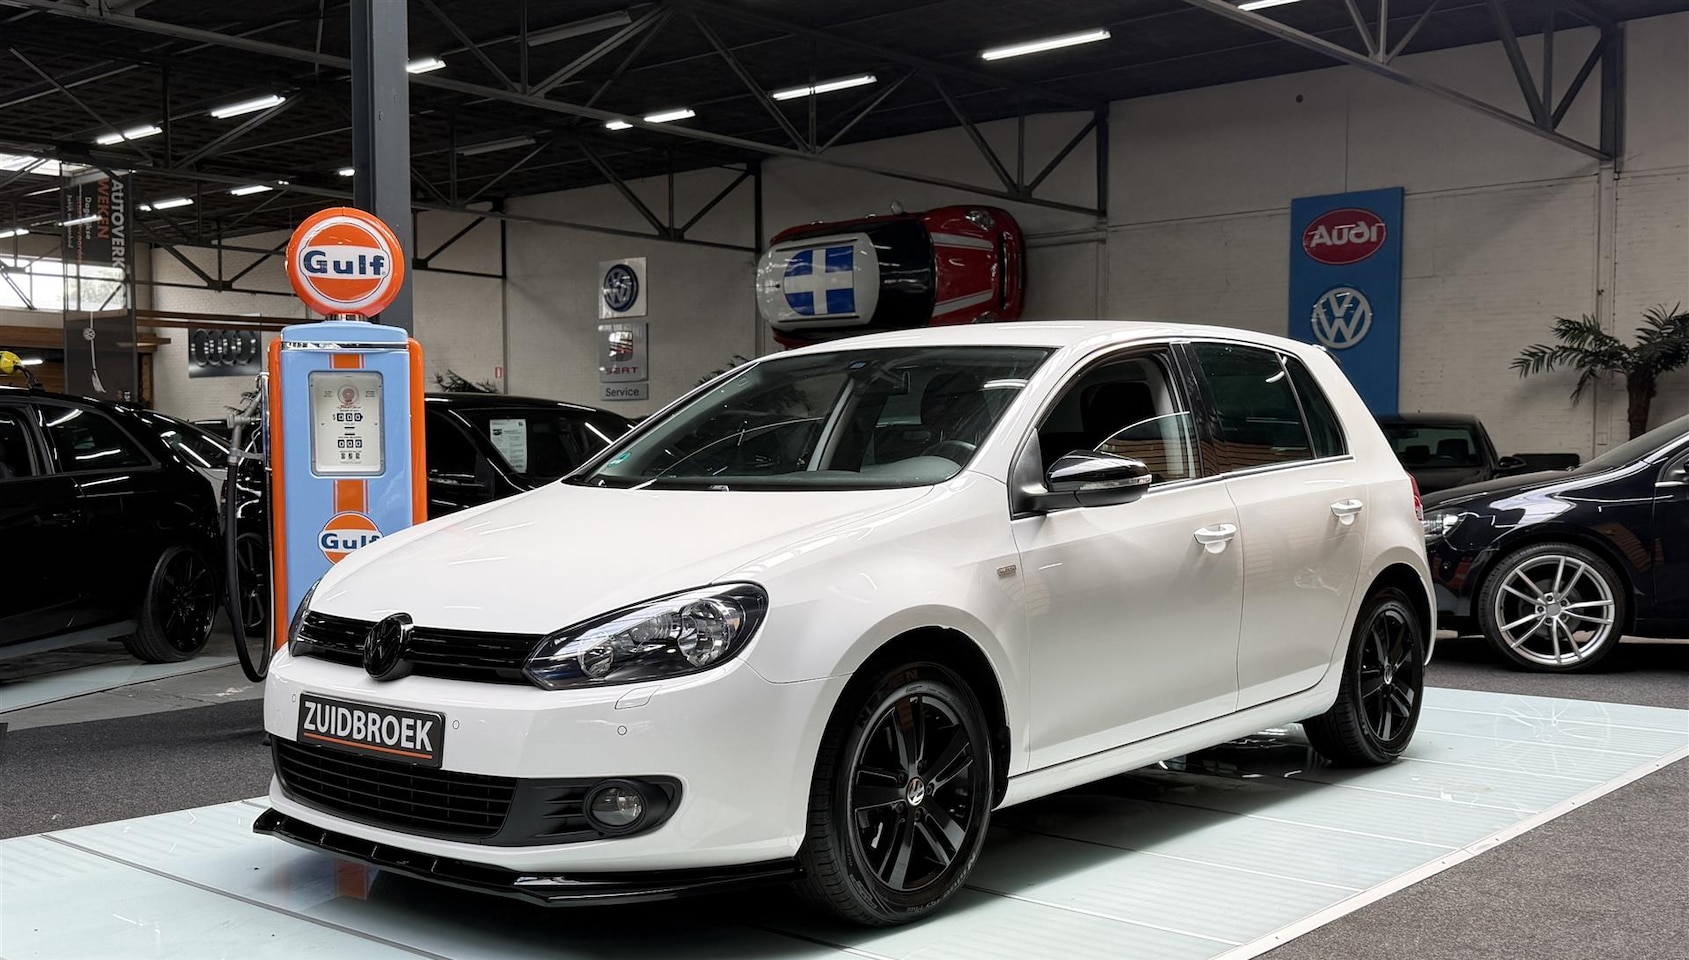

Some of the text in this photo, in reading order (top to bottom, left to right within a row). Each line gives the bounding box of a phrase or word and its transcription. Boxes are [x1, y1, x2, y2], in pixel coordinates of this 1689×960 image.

[303, 250, 385, 275] Gulf
[605, 387, 640, 397] Service
[303, 701, 433, 752] ZUIDBROEK
